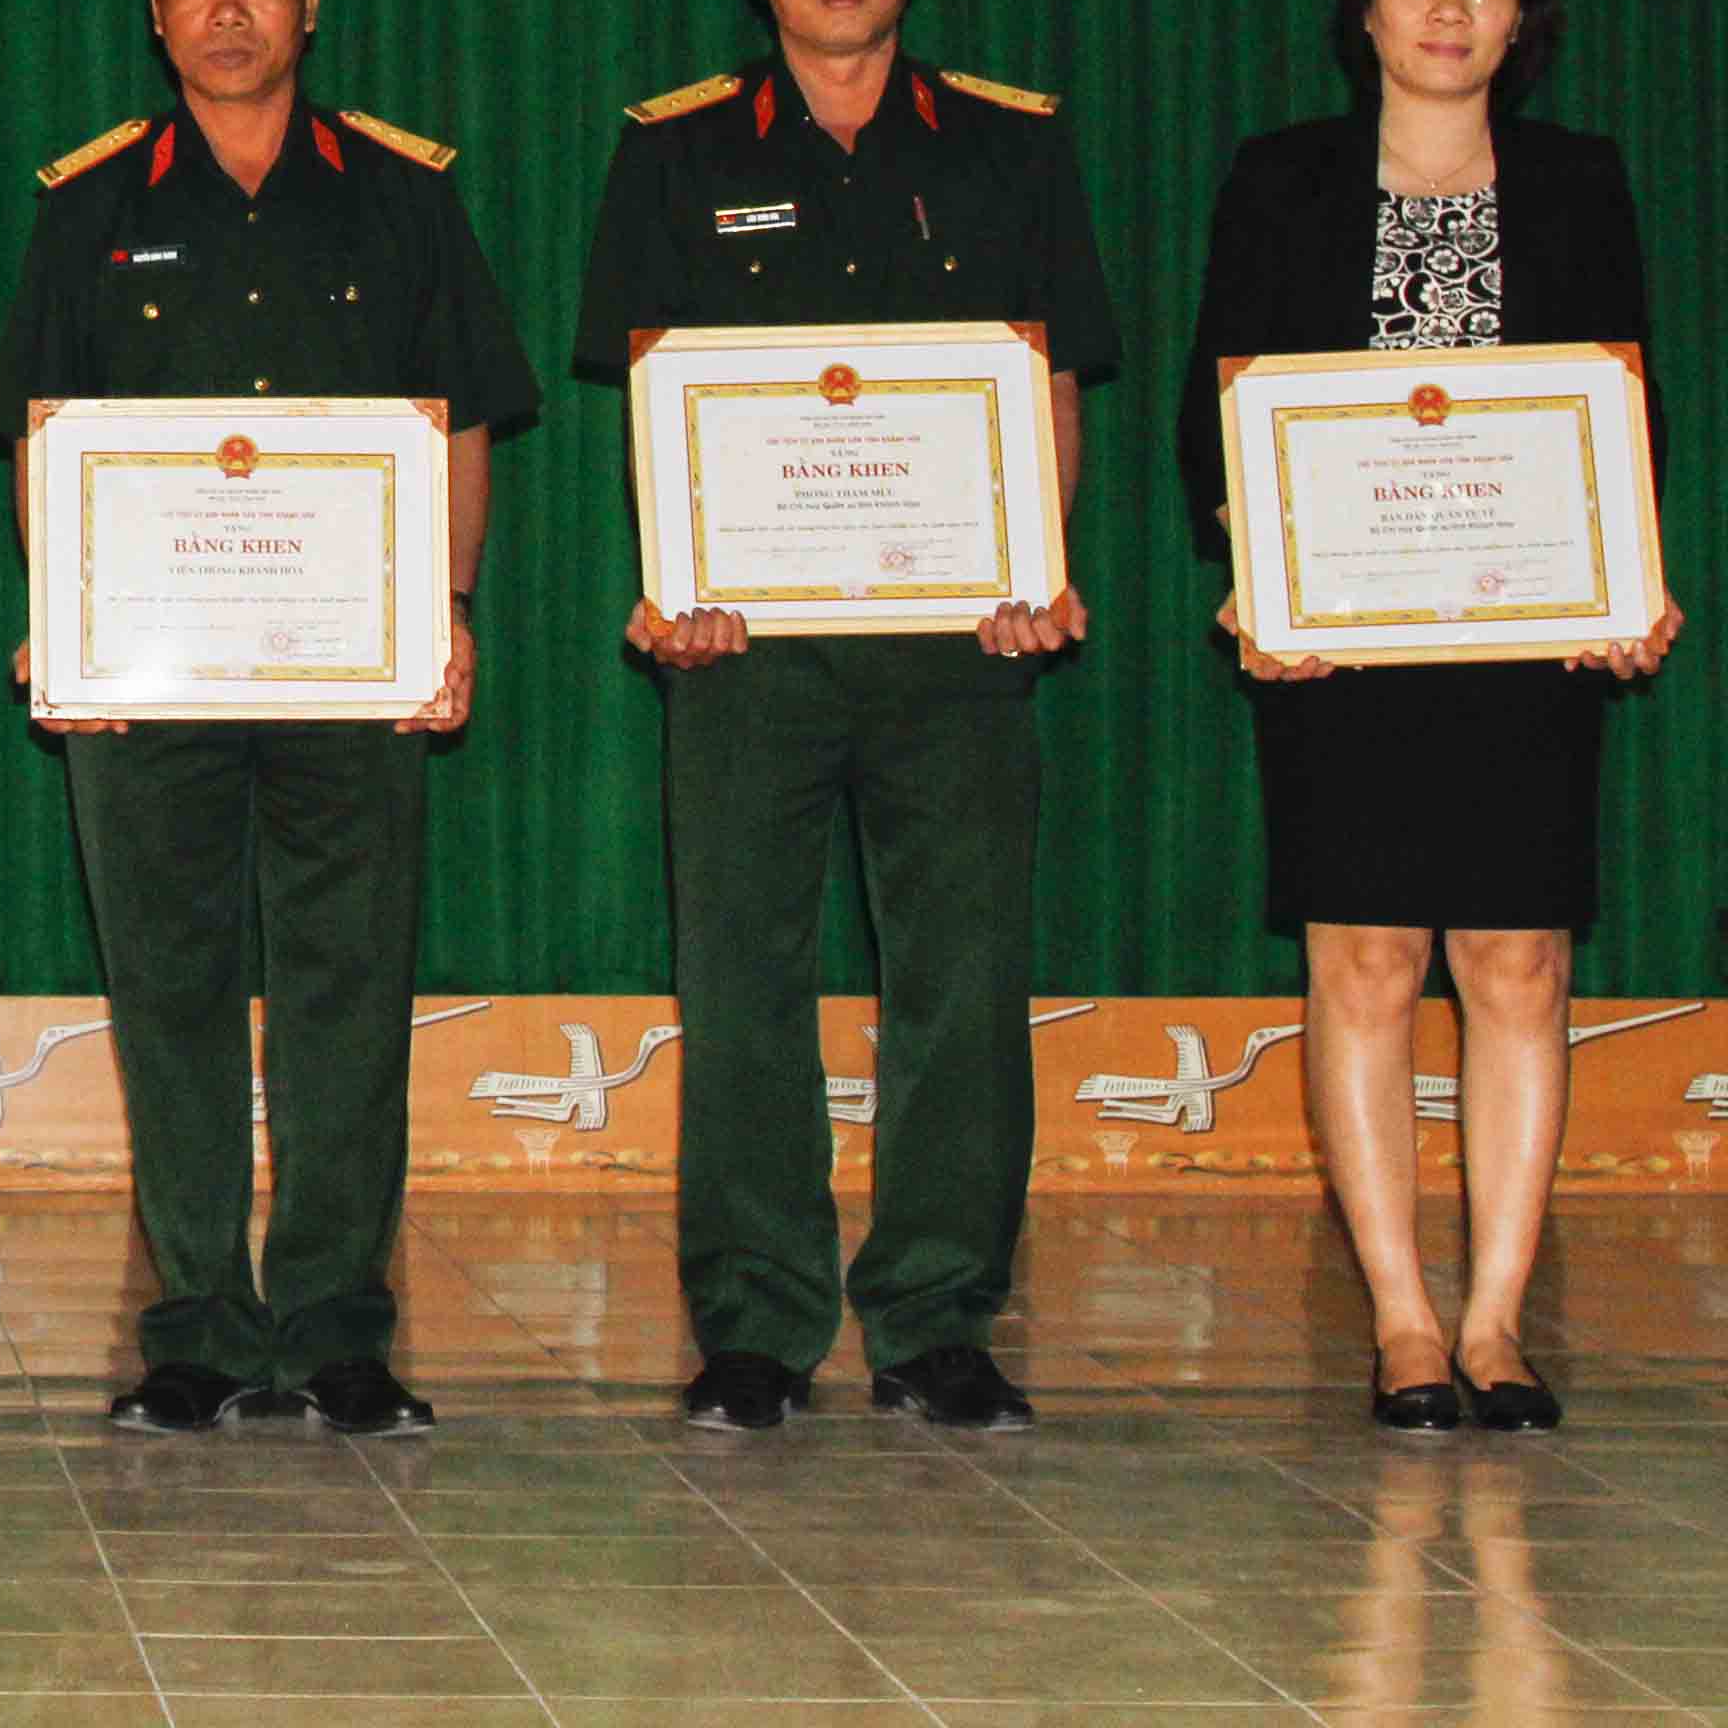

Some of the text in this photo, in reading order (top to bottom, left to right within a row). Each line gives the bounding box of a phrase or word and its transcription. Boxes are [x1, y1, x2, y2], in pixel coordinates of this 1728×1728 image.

[849, 461, 911, 478] KHEN
[173, 531, 304, 554] BẰNG KHEN
